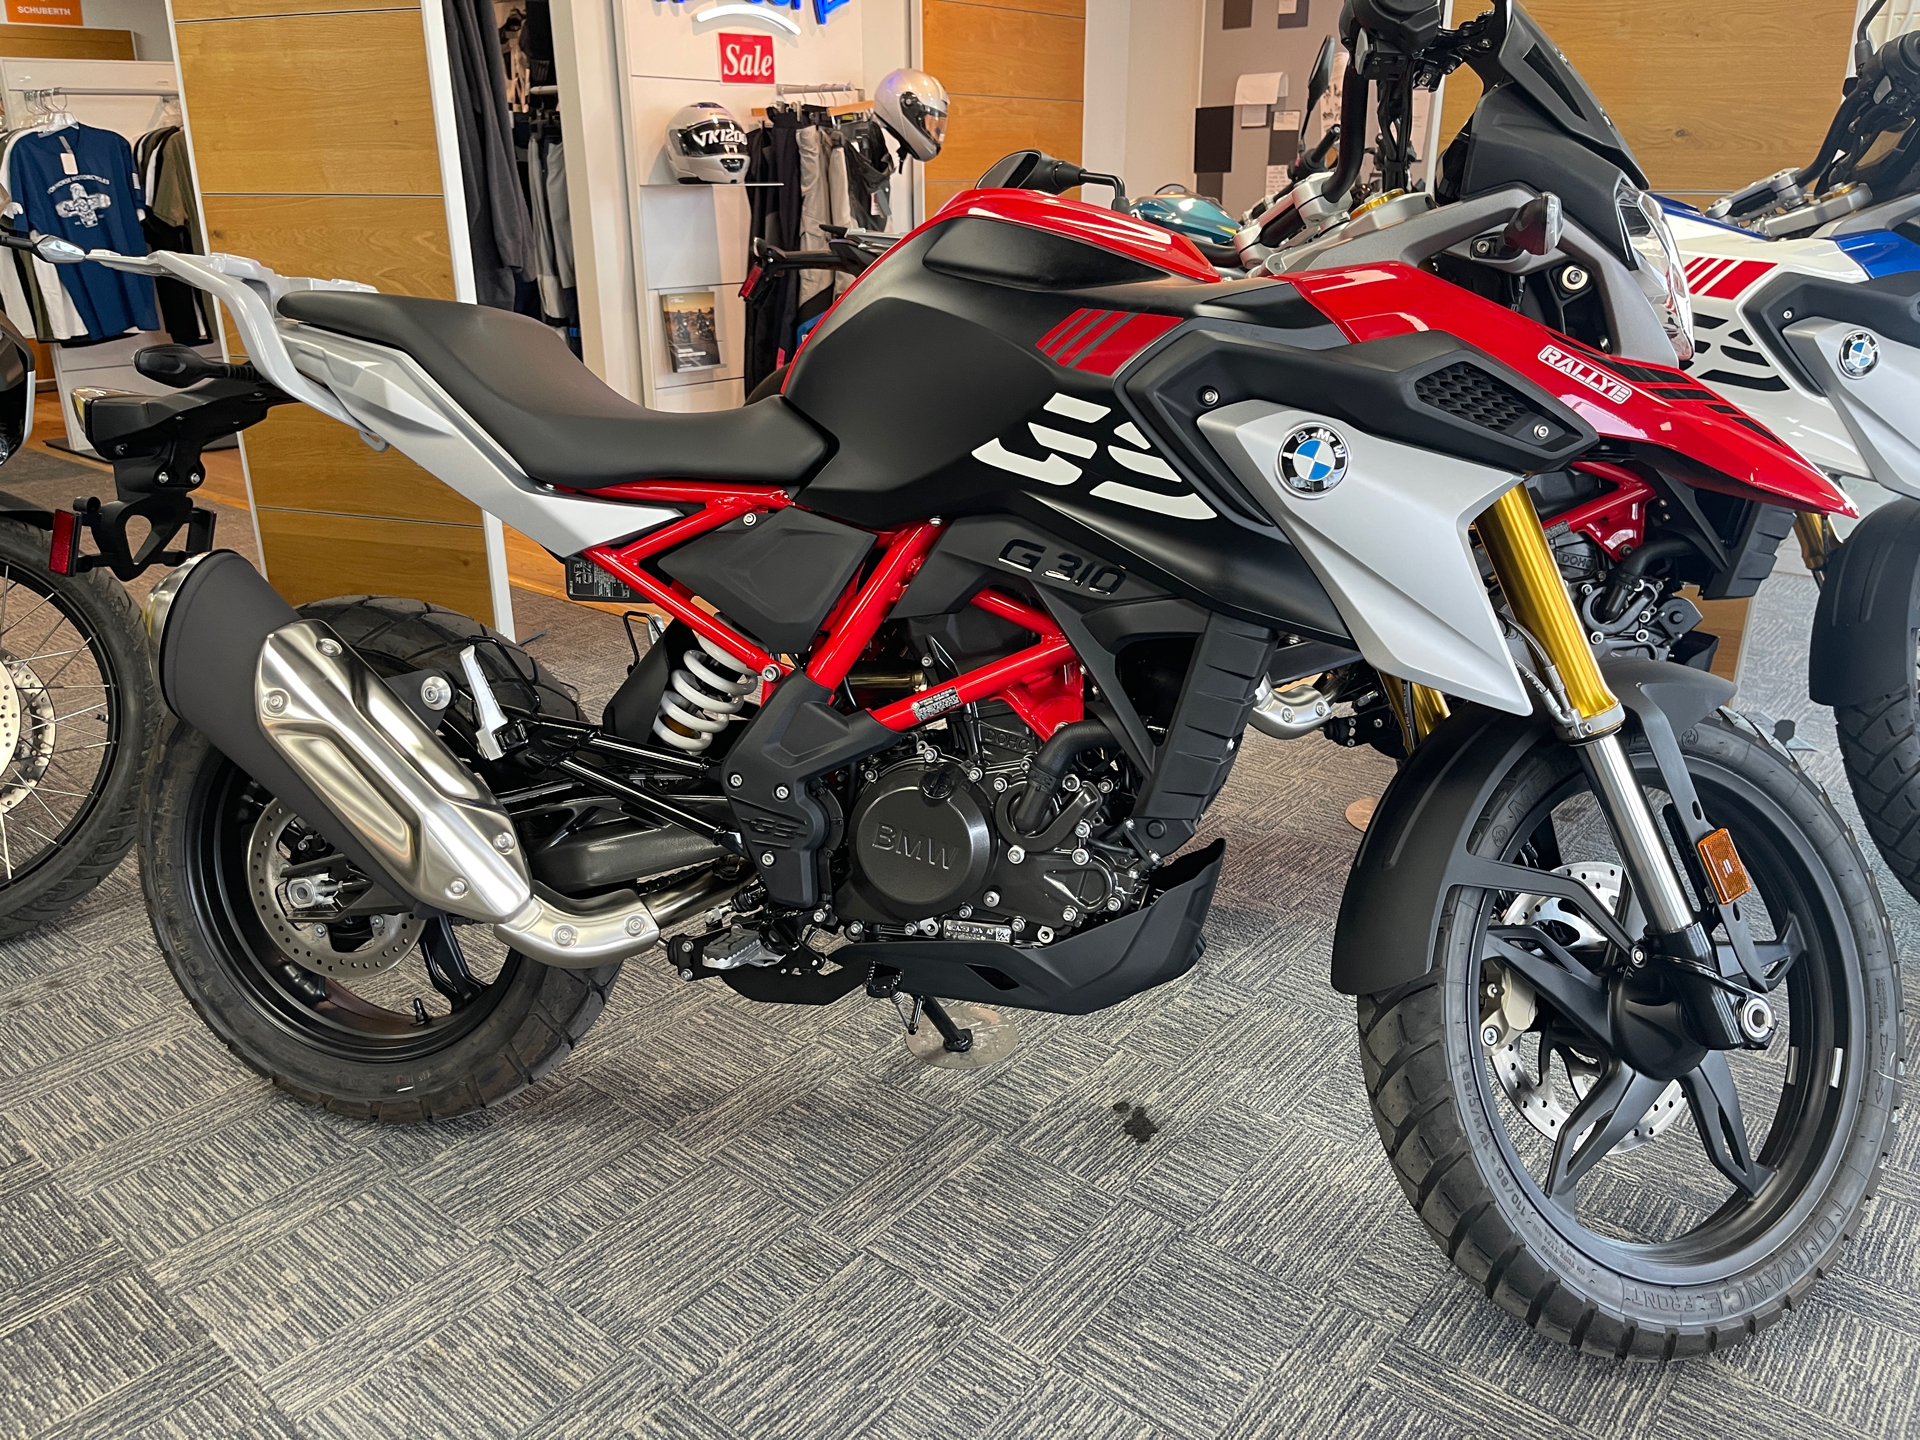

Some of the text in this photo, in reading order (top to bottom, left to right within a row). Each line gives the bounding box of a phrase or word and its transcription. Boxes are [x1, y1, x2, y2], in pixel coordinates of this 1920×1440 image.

[17, 6, 71, 15] SCHUBERTH
[724, 44, 773, 77] Sale
[1540, 346, 1631, 403] RALLYE
[1295, 428, 1347, 459] BMW
[998, 538, 1127, 596] G 310
[984, 729, 1031, 752] DOHC
[872, 822, 960, 871] BMW
[1495, 1168, 1527, 1217] 110/80
[1704, 1200, 1852, 1317] TOURANCE
[1630, 1288, 1695, 1312] FRONT
